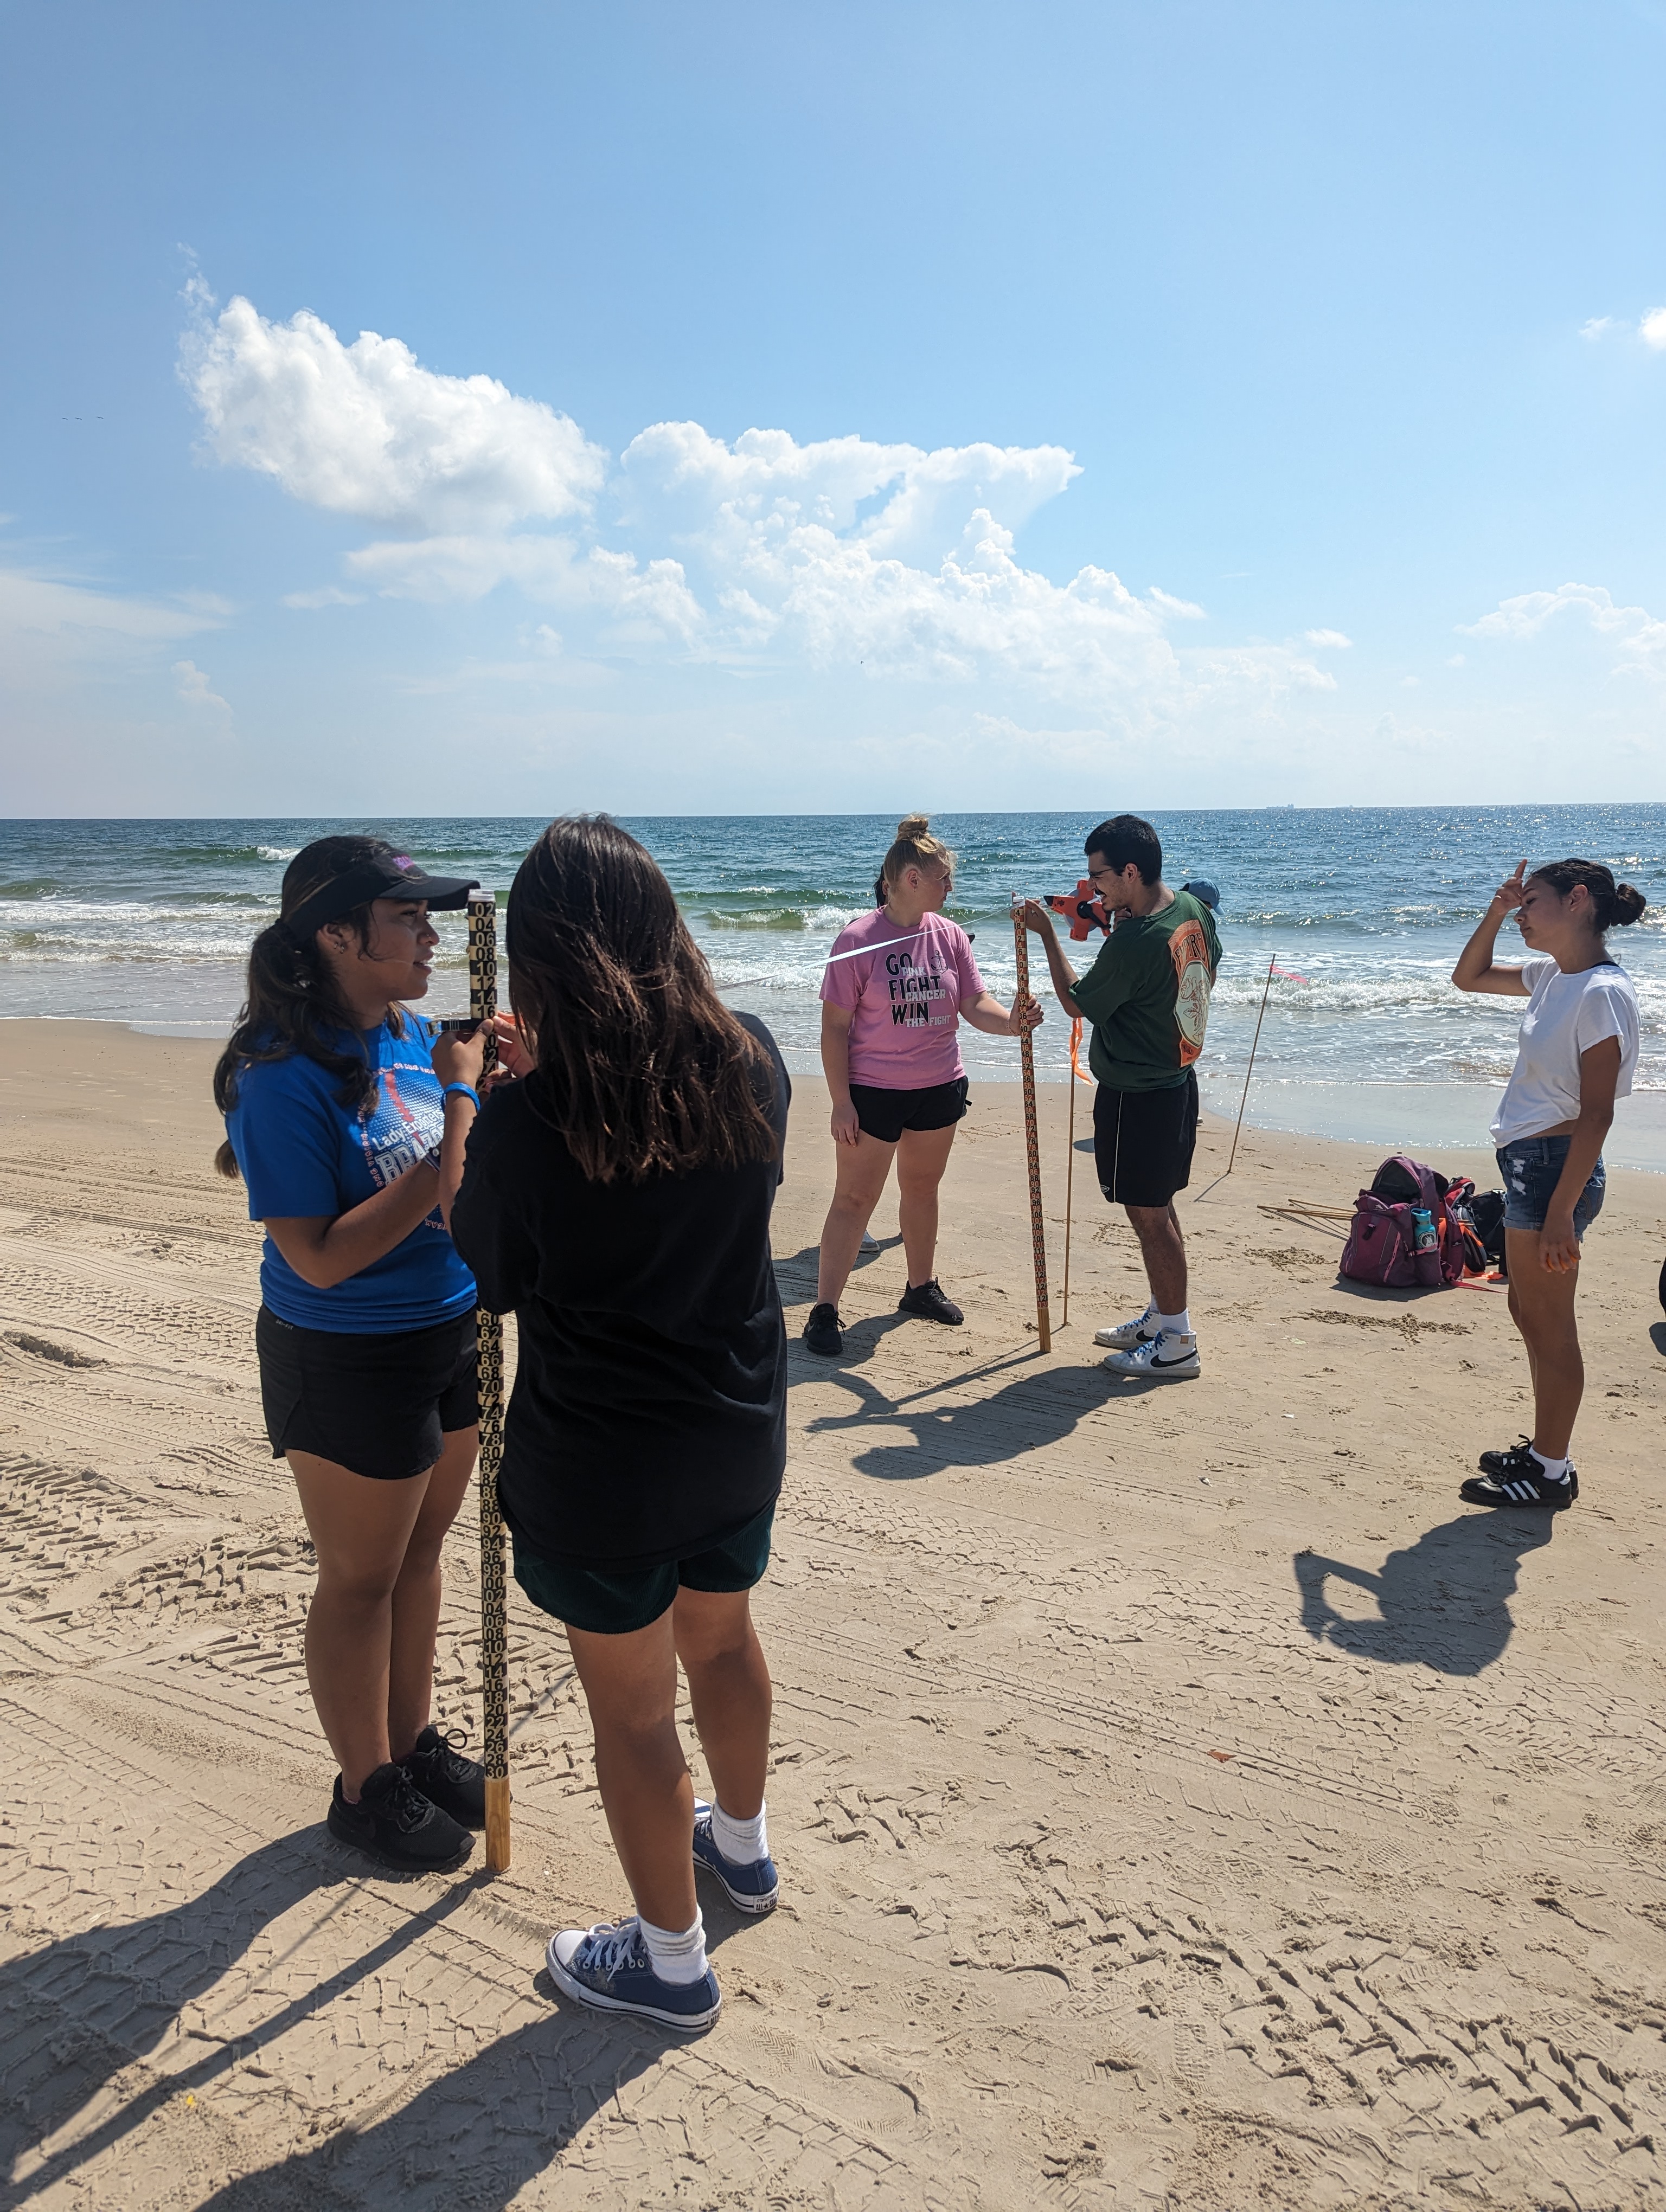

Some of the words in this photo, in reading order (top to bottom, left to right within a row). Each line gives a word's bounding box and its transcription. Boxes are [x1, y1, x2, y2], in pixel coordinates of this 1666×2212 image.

[475, 903, 495, 916] 02
[476, 917, 495, 931] 04
[476, 932, 495, 946] 06
[476, 947, 494, 961] 08
[477, 961, 495, 975] 10
[886, 953, 913, 976] GO
[477, 976, 495, 990] 12
[888, 975, 940, 1001] FIGHT
[477, 990, 496, 1004] 14
[905, 989, 946, 1002] CANCER
[478, 1005, 496, 1019] 16
[891, 1001, 929, 1026] WIN
[905, 1018, 925, 1027] THE
[929, 1015, 951, 1026] FIGHT
[372, 1128, 406, 1150] Lady
[401, 1108, 445, 1134] Exporters
[481, 1314, 499, 1326] 60
[481, 1326, 499, 1339] 62
[481, 1340, 499, 1353] 64
[481, 1353, 499, 1366] 66
[481, 1367, 499, 1380] 68
[482, 1380, 499, 1392] 70
[482, 1393, 499, 1406] 72
[482, 1407, 500, 1419] 74
[482, 1420, 499, 1433] 76
[482, 1433, 500, 1446] 78
[483, 1447, 500, 1459] 80
[483, 1459, 500, 1472] 82
[483, 1473, 498, 1485] 84
[483, 1499, 498, 1512] 88
[483, 1512, 500, 1525] 90
[483, 1525, 501, 1538] 92
[483, 1538, 501, 1550] 94
[483, 1551, 501, 1563] 96
[484, 1564, 501, 1576] 98
